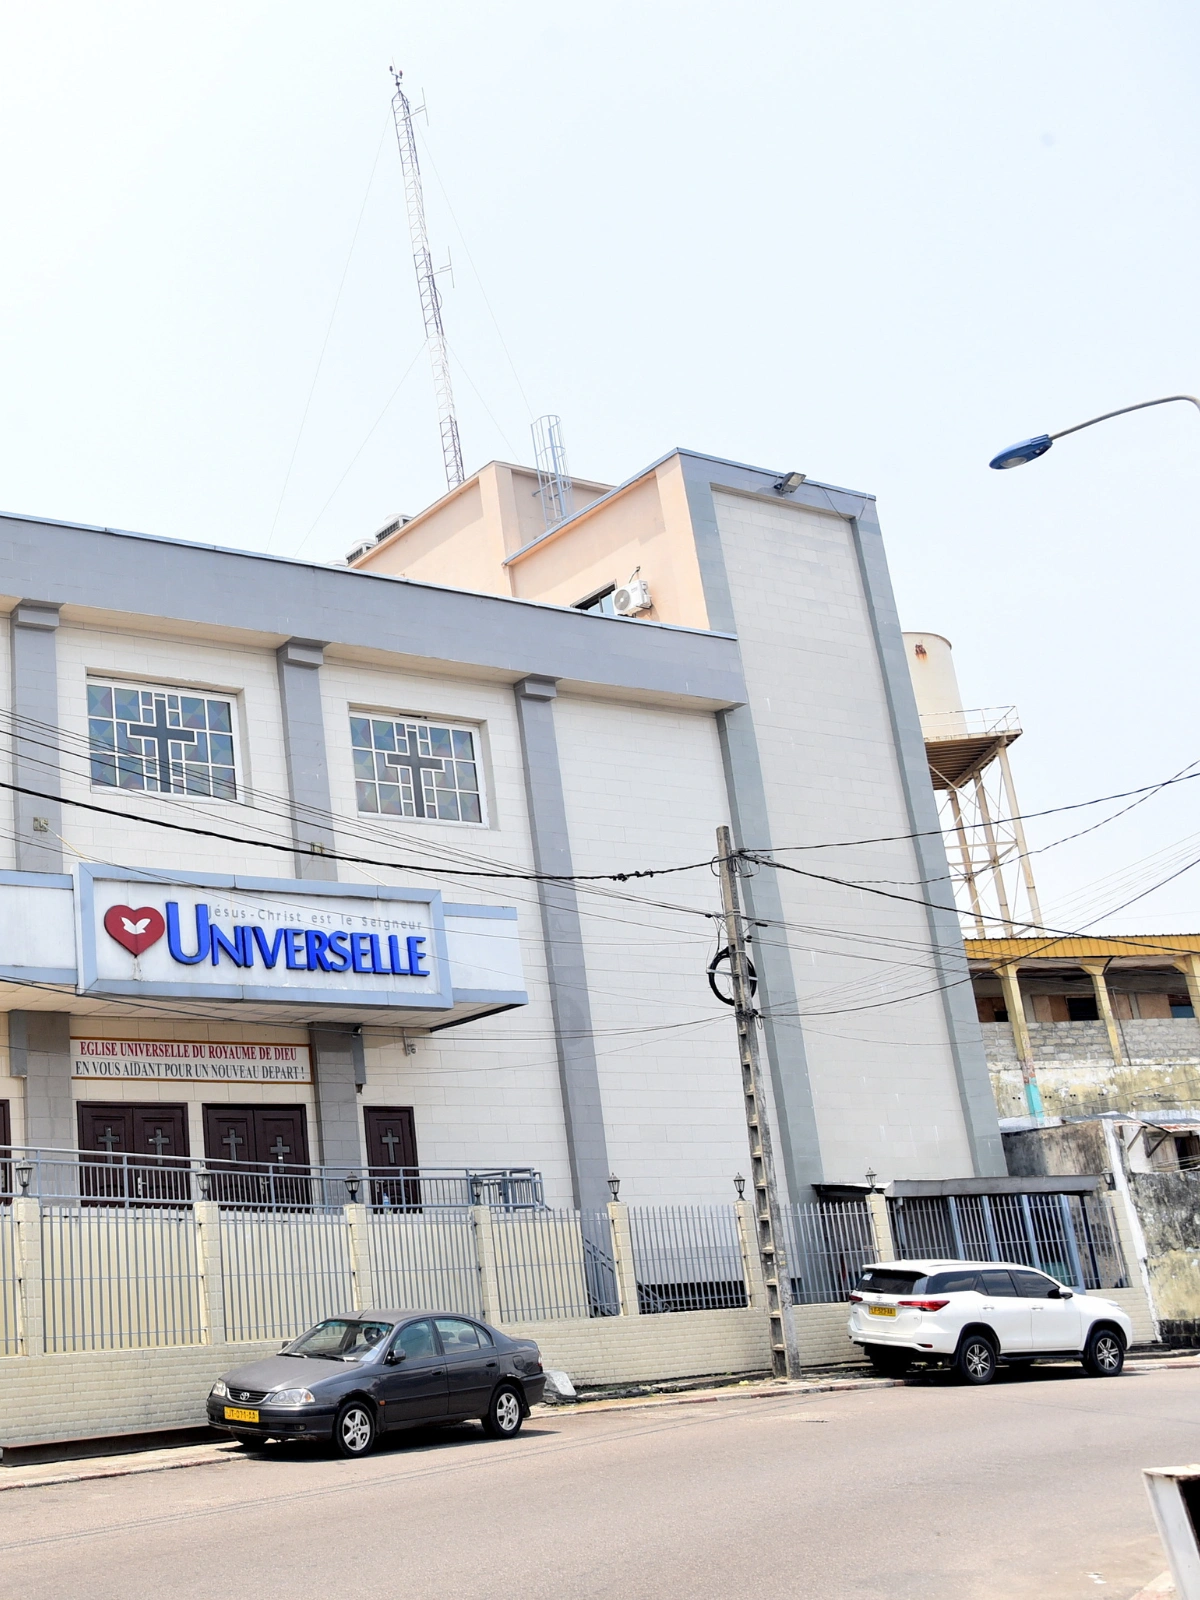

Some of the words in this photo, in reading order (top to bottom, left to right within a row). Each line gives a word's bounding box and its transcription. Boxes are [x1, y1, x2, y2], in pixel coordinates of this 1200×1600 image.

[311, 914, 332, 925] est
[341, 914, 353, 926] le
[361, 916, 423, 931] Seigneur
[165, 901, 431, 977] UNIVERSELLE
[80, 1041, 118, 1056] EGLISE
[120, 1042, 190, 1058] UNIVERSELLE
[192, 1044, 206, 1058] DU
[208, 1045, 257, 1060] ROYAUME
[259, 1046, 272, 1060] DE
[274, 1047, 297, 1061] DIEU
[75, 1061, 90, 1075] EN
[92, 1061, 121, 1076] VOUS
[122, 1062, 164, 1077] AIDANT
[164, 1063, 193, 1077] POUR
[195, 1064, 209, 1078] UN
[211, 1064, 259, 1079] NOUVEAU
[262, 1065, 299, 1080] DEPART
